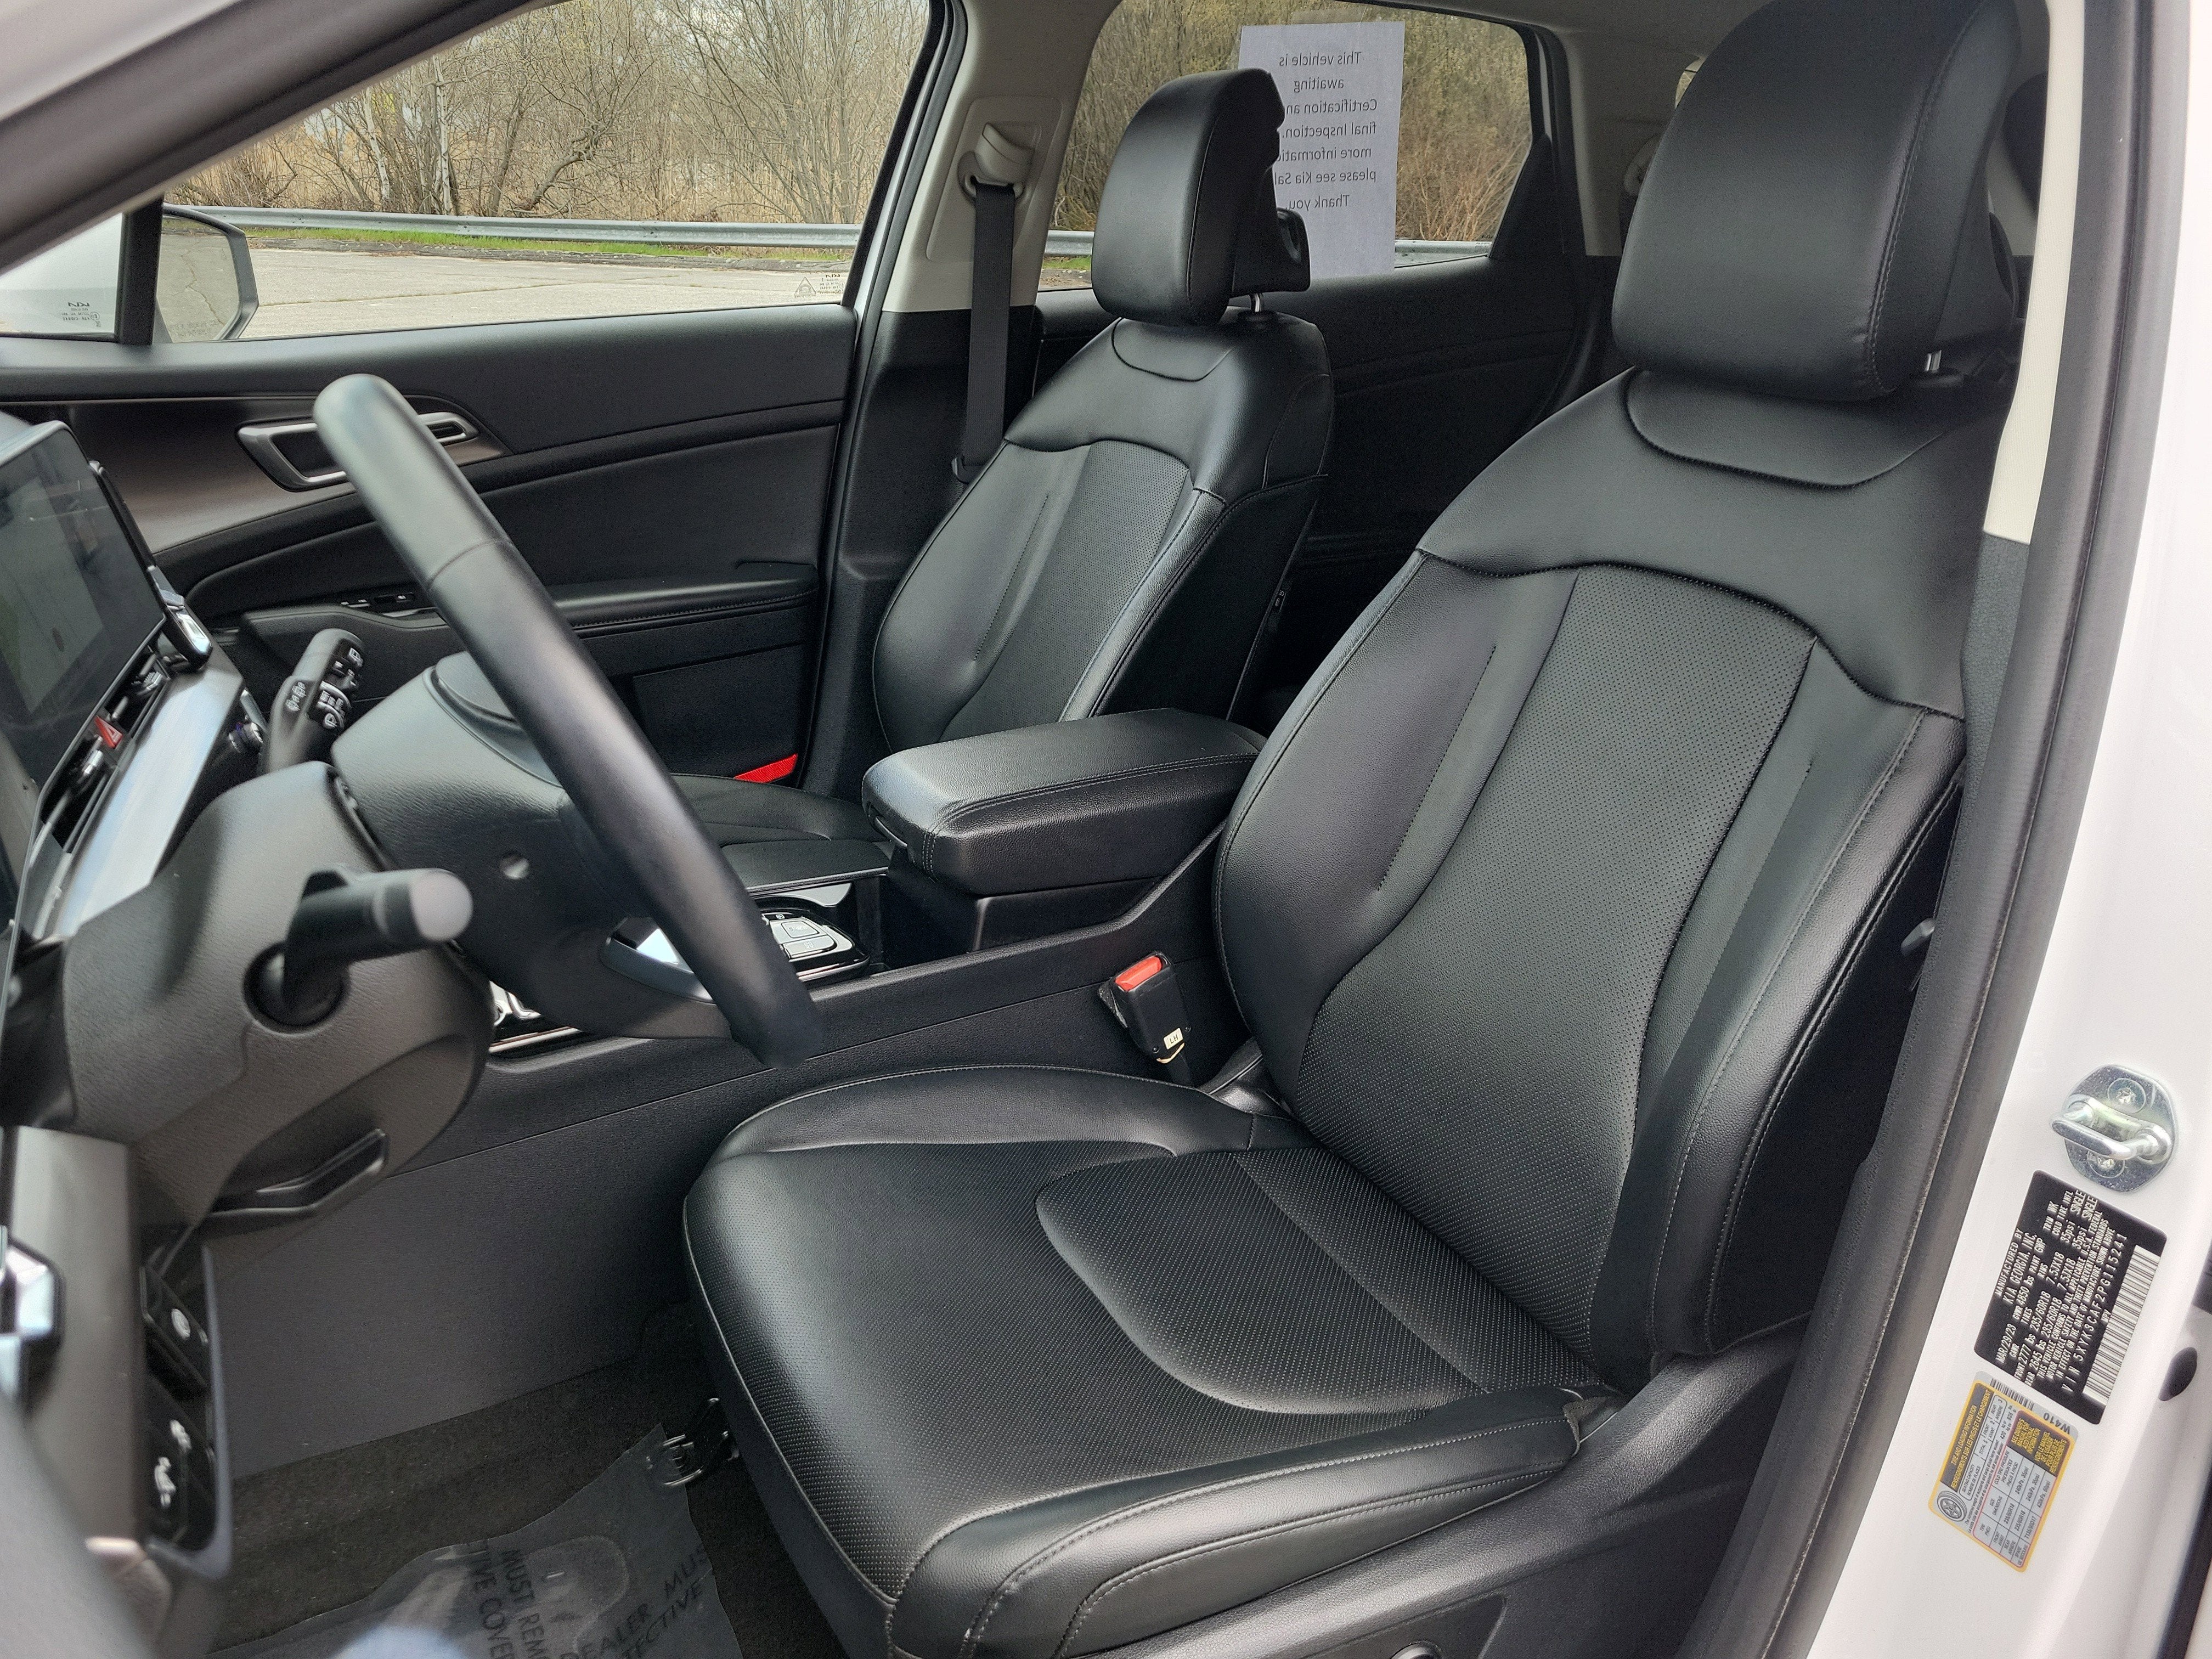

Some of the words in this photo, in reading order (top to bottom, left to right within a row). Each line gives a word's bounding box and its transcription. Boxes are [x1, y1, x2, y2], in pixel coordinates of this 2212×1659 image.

[1169, 1034, 1178, 1043] LH
[2062, 1188, 2073, 1205] INFL
[2069, 1189, 2086, 1216] SINGLE
[2046, 1200, 2059, 1215] WK
[2056, 1204, 2068, 1221] TIRE
[2081, 1195, 2098, 1222] SINGLE
[2042, 1215, 2054, 1232] TRIM
[2051, 1219, 2063, 1237] COLD
[2059, 1219, 2078, 1245] 35psi
[2087, 1209, 2102, 1235] FEDERAL
[2071, 1224, 2089, 1251] 35psi
[2080, 1233, 2094, 1255] U.S.A.
[2092, 1217, 2109, 1250] STANDARDS
[2102, 1226, 2115, 1246] ABOVE
[2034, 1236, 2046, 1254] GWP
[2095, 1245, 2108, 1265] SHOWN
[1994, 1240, 2019, 1296] MANUFACTURED
[2014, 1227, 2023, 1239] BY
[2002, 1285, 2017, 1305] KIA
[2021, 1229, 2037, 1250] INC.
[2028, 1254, 2041, 1274] PAINT
[2037, 1262, 2048, 1279] RIMS
[2045, 1250, 2065, 1285] 7.5JX18
[2080, 1249, 2098, 1284] PREVENTION
[2056, 1256, 2076, 1292] 7.5JX18
[2068, 1256, 2086, 1291] APPLICABLE
[2082, 1264, 2102, 1303] MANUFACTURE
[2015, 1285, 2030, 1306] 4850
[2064, 1290, 2074, 1303] ALL
[2073, 1284, 2085, 1303] THEFT
[2020, 1306, 2033, 1325] TIRES
[2029, 1289, 2051, 1332] 235/60R18
[2040, 1296, 2062, 1338] 235/60R18
[2061, 1302, 2069, 1312] TO
[2068, 1302, 2079, 1315] AND
[2079, 1302, 2088, 1312] OF
[2100, 1308, 2111, 1323] MPV
[2051, 1312, 2066, 1340] CONFORMS
[2061, 1314, 2074, 1337] SAFETY
[2073, 1311, 2085, 1327] DATE
[1995, 1321, 2016, 1364] MAR/29/23
[2069, 1326, 2079, 1339] THE
[2009, 1342, 2020, 1358] GAWR
[2017, 1343, 2032, 1364] 2777
[2042, 1339, 2056, 1365] VEHICLE
[2052, 1336, 2066, 1361] VEHICLE
[2066, 1339, 2075, 1349] ON
[2028, 1349, 2043, 1371] 2645
[2046, 1360, 2058, 1379] MOTOR
[2058, 1348, 2071, 1370] EFFECT
[2013, 1361, 2025, 1380] FRONT
[2024, 1370, 2035, 1386] REAR
[2037, 1363, 2048, 1379] THIS
[2055, 1369, 2064, 1379] IN
[2043, 1412, 2070, 1434] W410
[664, 1544, 708, 1599] MUS
[501, 1549, 535, 1602] MUST
[519, 1612, 550, 1659] REM
